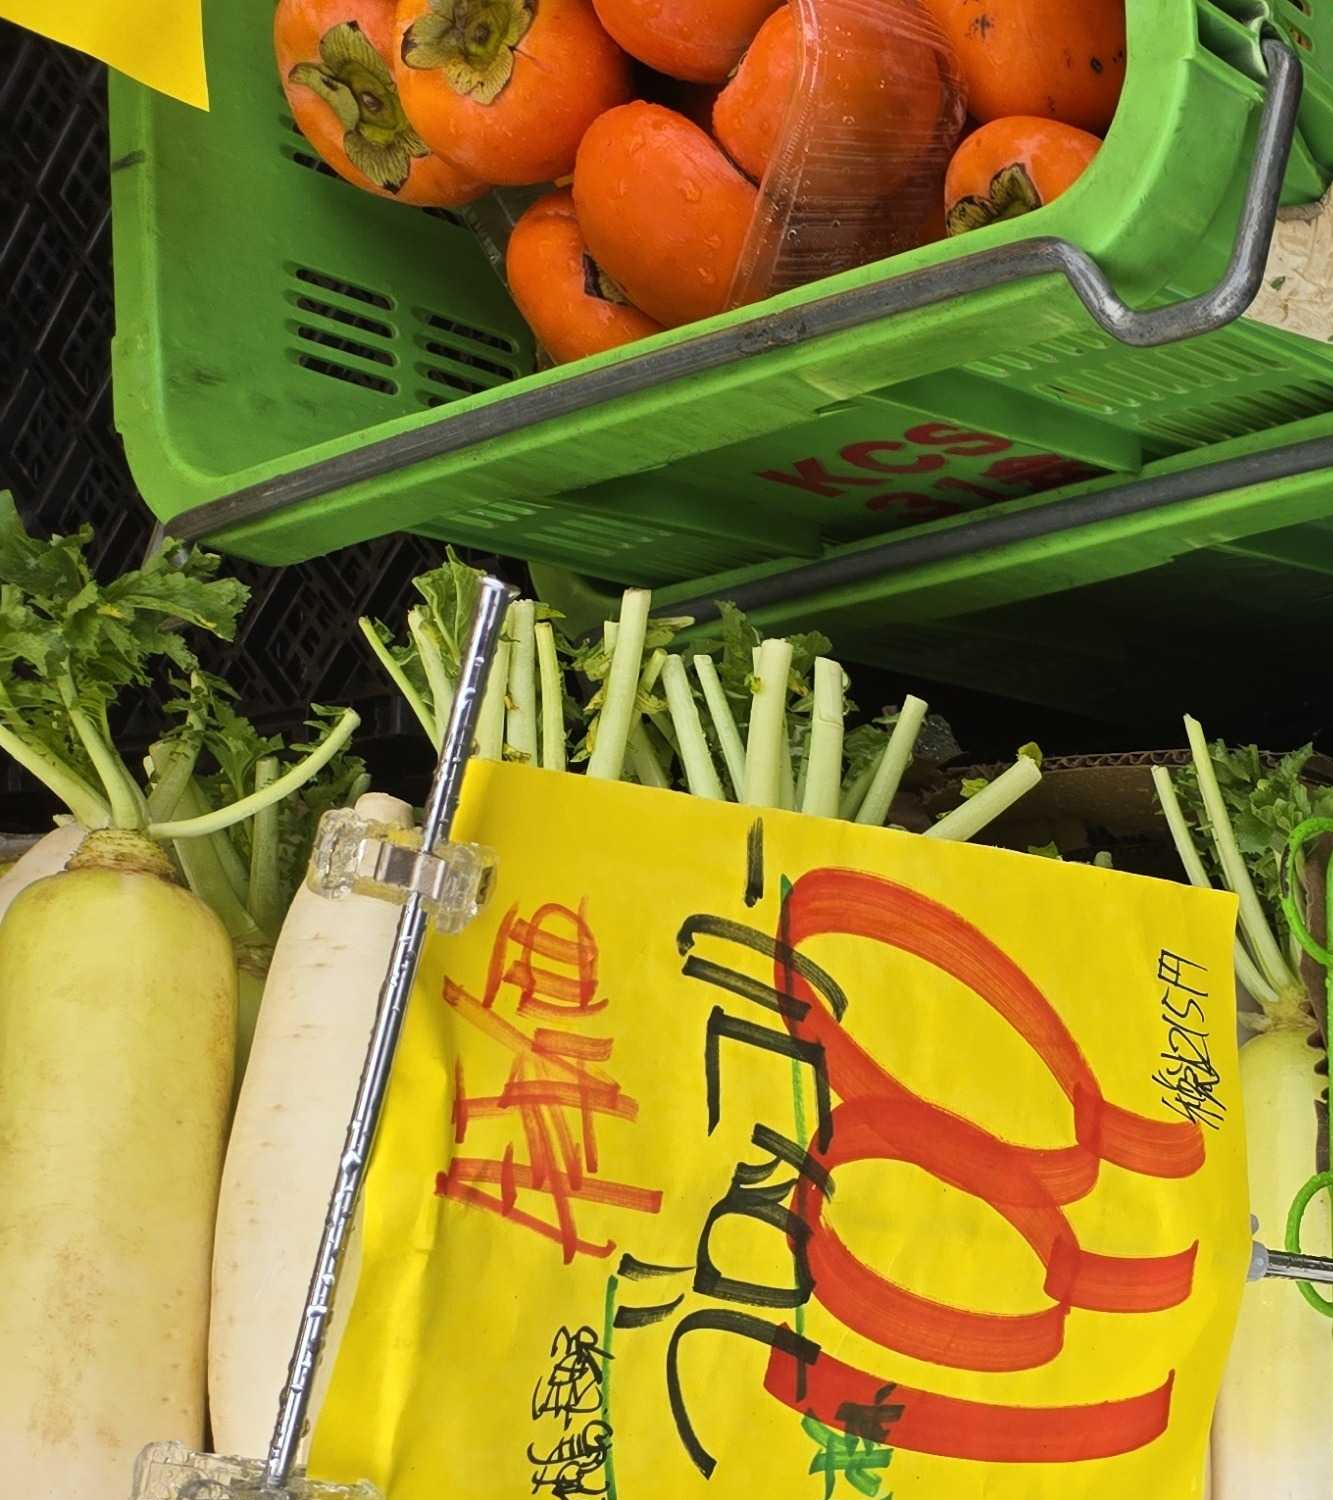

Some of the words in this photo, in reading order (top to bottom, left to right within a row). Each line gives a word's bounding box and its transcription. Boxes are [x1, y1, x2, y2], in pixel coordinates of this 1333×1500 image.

[753, 421, 1012, 497] KCS
[434, 895, 663, 1265] 特価
[613, 817, 849, 1478] ブロッコリー
